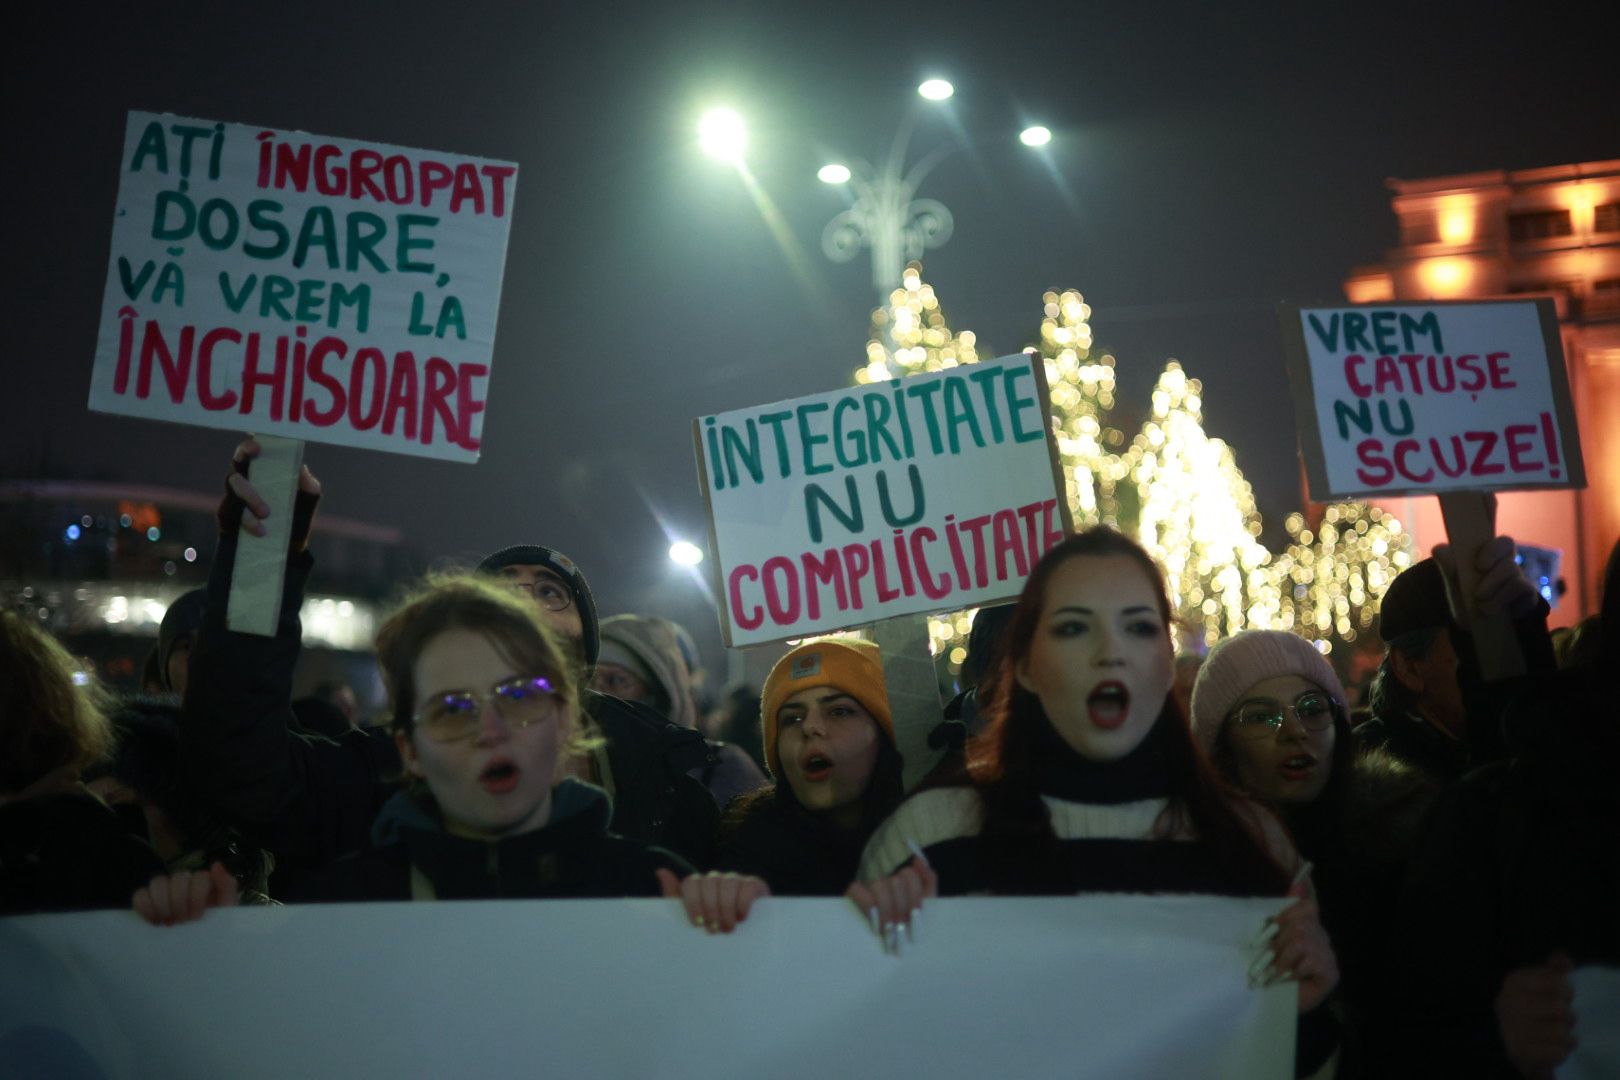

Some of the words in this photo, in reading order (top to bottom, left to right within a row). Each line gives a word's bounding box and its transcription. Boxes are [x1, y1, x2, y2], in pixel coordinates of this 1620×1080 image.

[130, 121, 225, 192] AȚI
[257, 131, 516, 217] ÎNGROPAT
[151, 190, 450, 288] DOSARE,
[118, 247, 185, 306] VĂ
[219, 271, 371, 333] VREM
[408, 291, 467, 339] LA
[1308, 311, 1443, 355] VREM
[113, 305, 488, 451] ÎNCHISOARE
[1333, 398, 1414, 440] NU
[1344, 352, 1517, 402] CATUȘE
[704, 365, 1044, 490] INTEGRITATE
[1356, 412, 1560, 487] SCUZE!
[803, 464, 926, 543] NU
